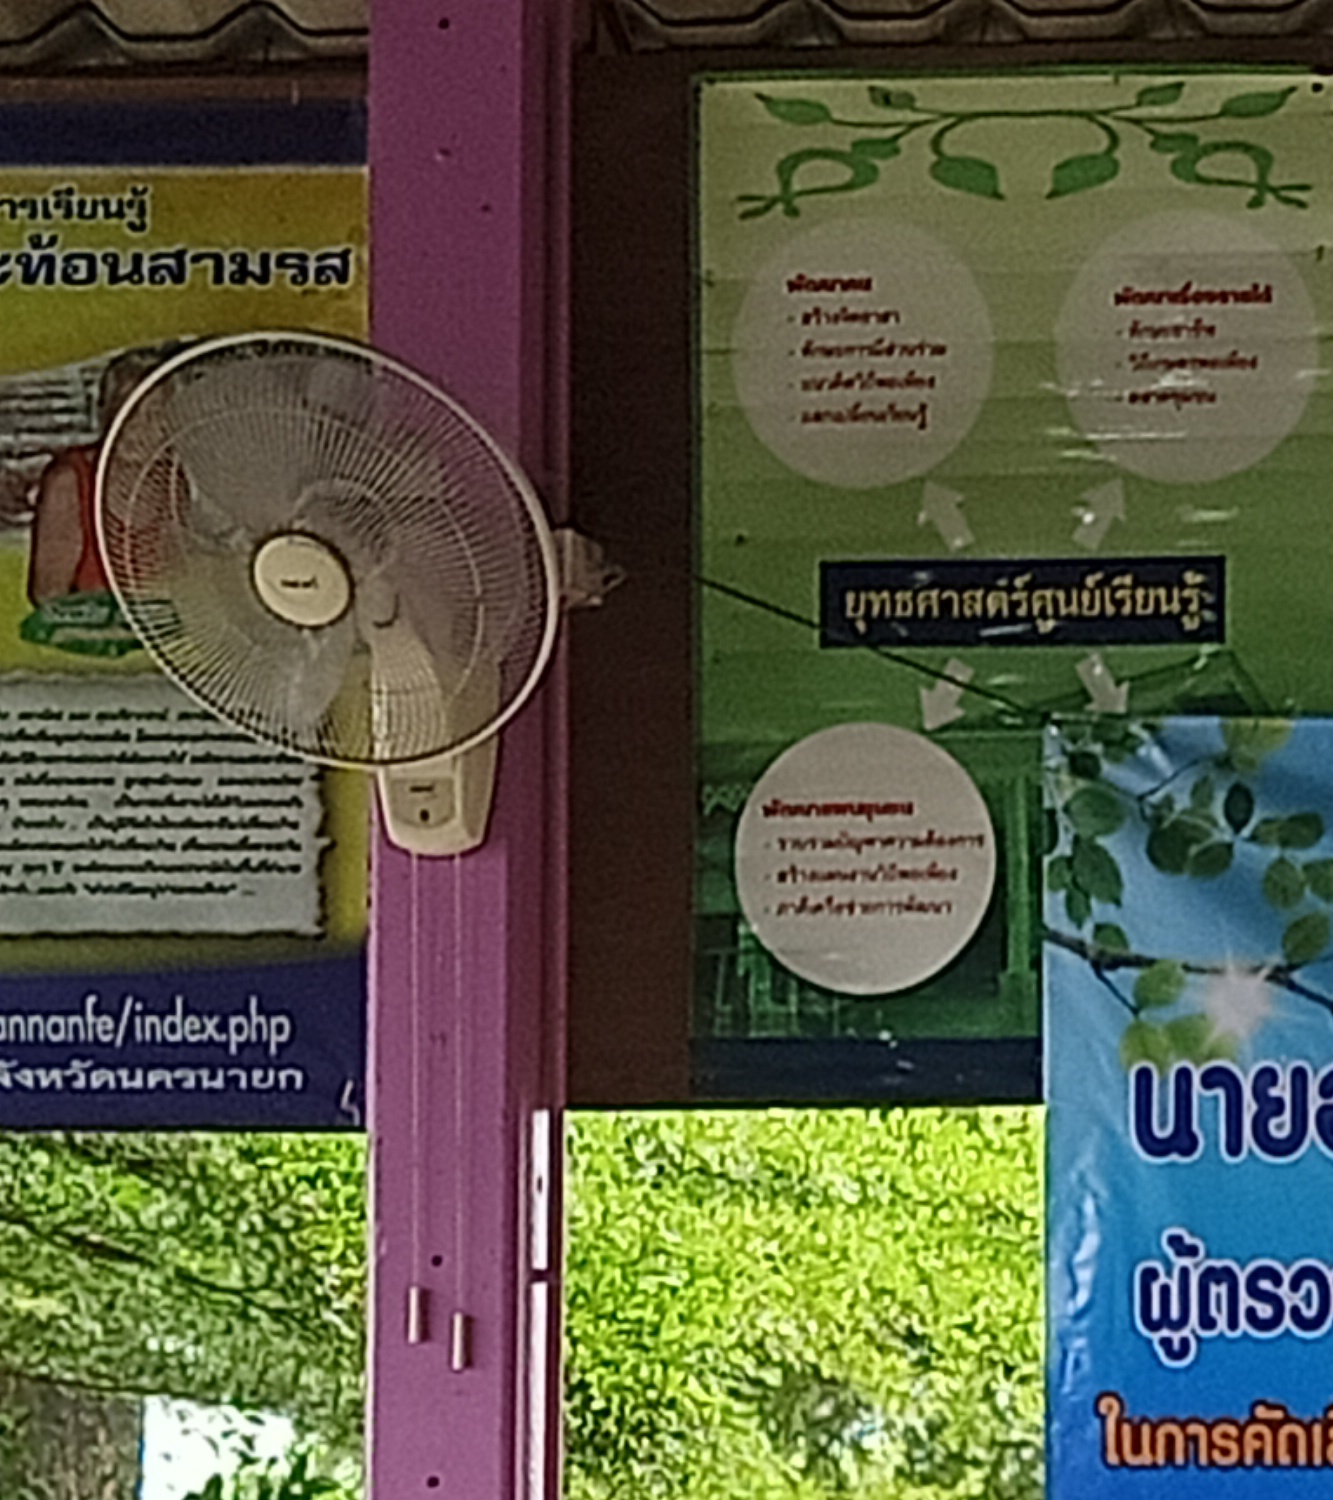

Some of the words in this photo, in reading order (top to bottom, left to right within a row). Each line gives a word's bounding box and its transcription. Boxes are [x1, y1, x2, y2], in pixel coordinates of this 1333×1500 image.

[845, 570, 1208, 634] ยุทธศาสตร์ศูนย์เรียนรู้
